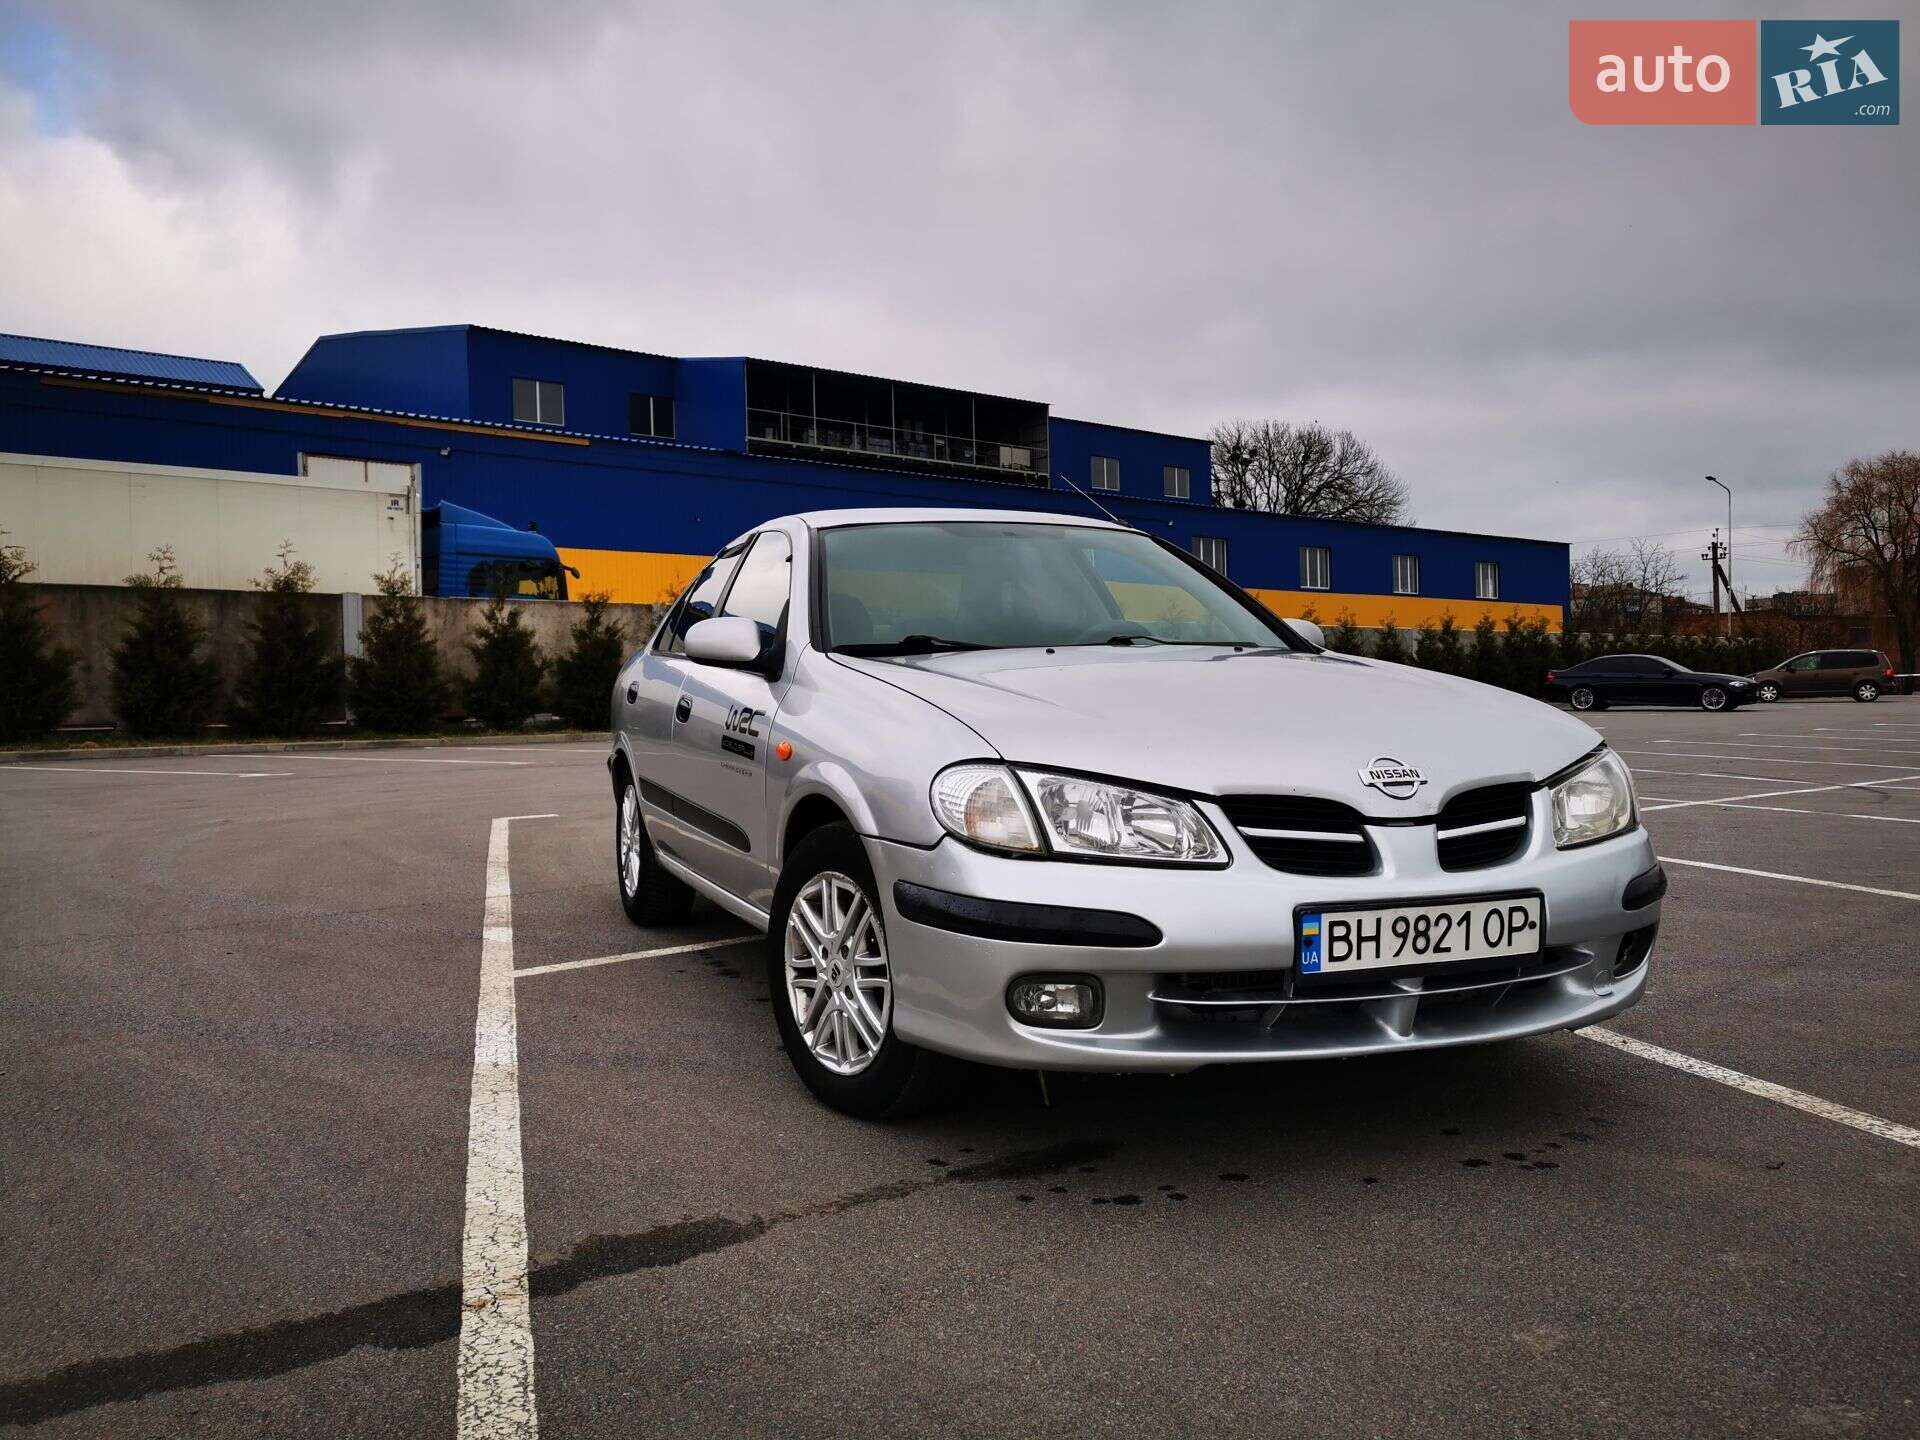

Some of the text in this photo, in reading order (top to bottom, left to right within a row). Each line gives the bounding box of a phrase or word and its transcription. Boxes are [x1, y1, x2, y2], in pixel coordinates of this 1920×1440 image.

[1368, 769, 1420, 780] NISSAN
[1328, 905, 1529, 963] BH 9821 OP
[1302, 951, 1318, 965] UA
